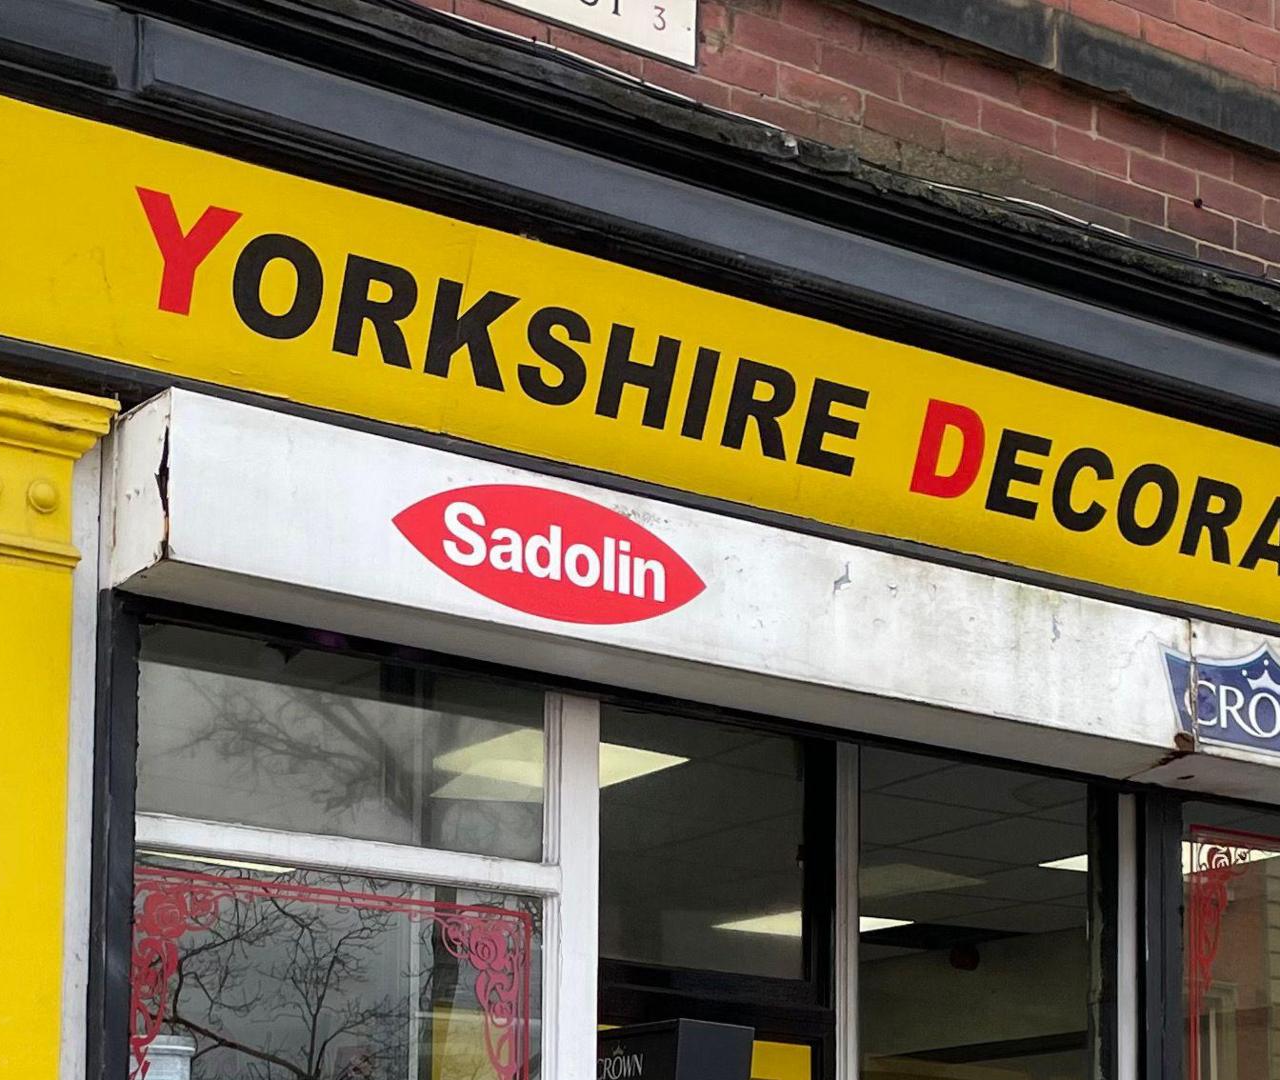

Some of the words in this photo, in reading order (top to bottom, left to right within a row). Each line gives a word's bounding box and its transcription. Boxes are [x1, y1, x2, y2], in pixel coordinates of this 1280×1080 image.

[652, 5, 667, 31] 3
[136, 185, 870, 478] YORKSHIRE
[440, 500, 667, 603] Sadolin
